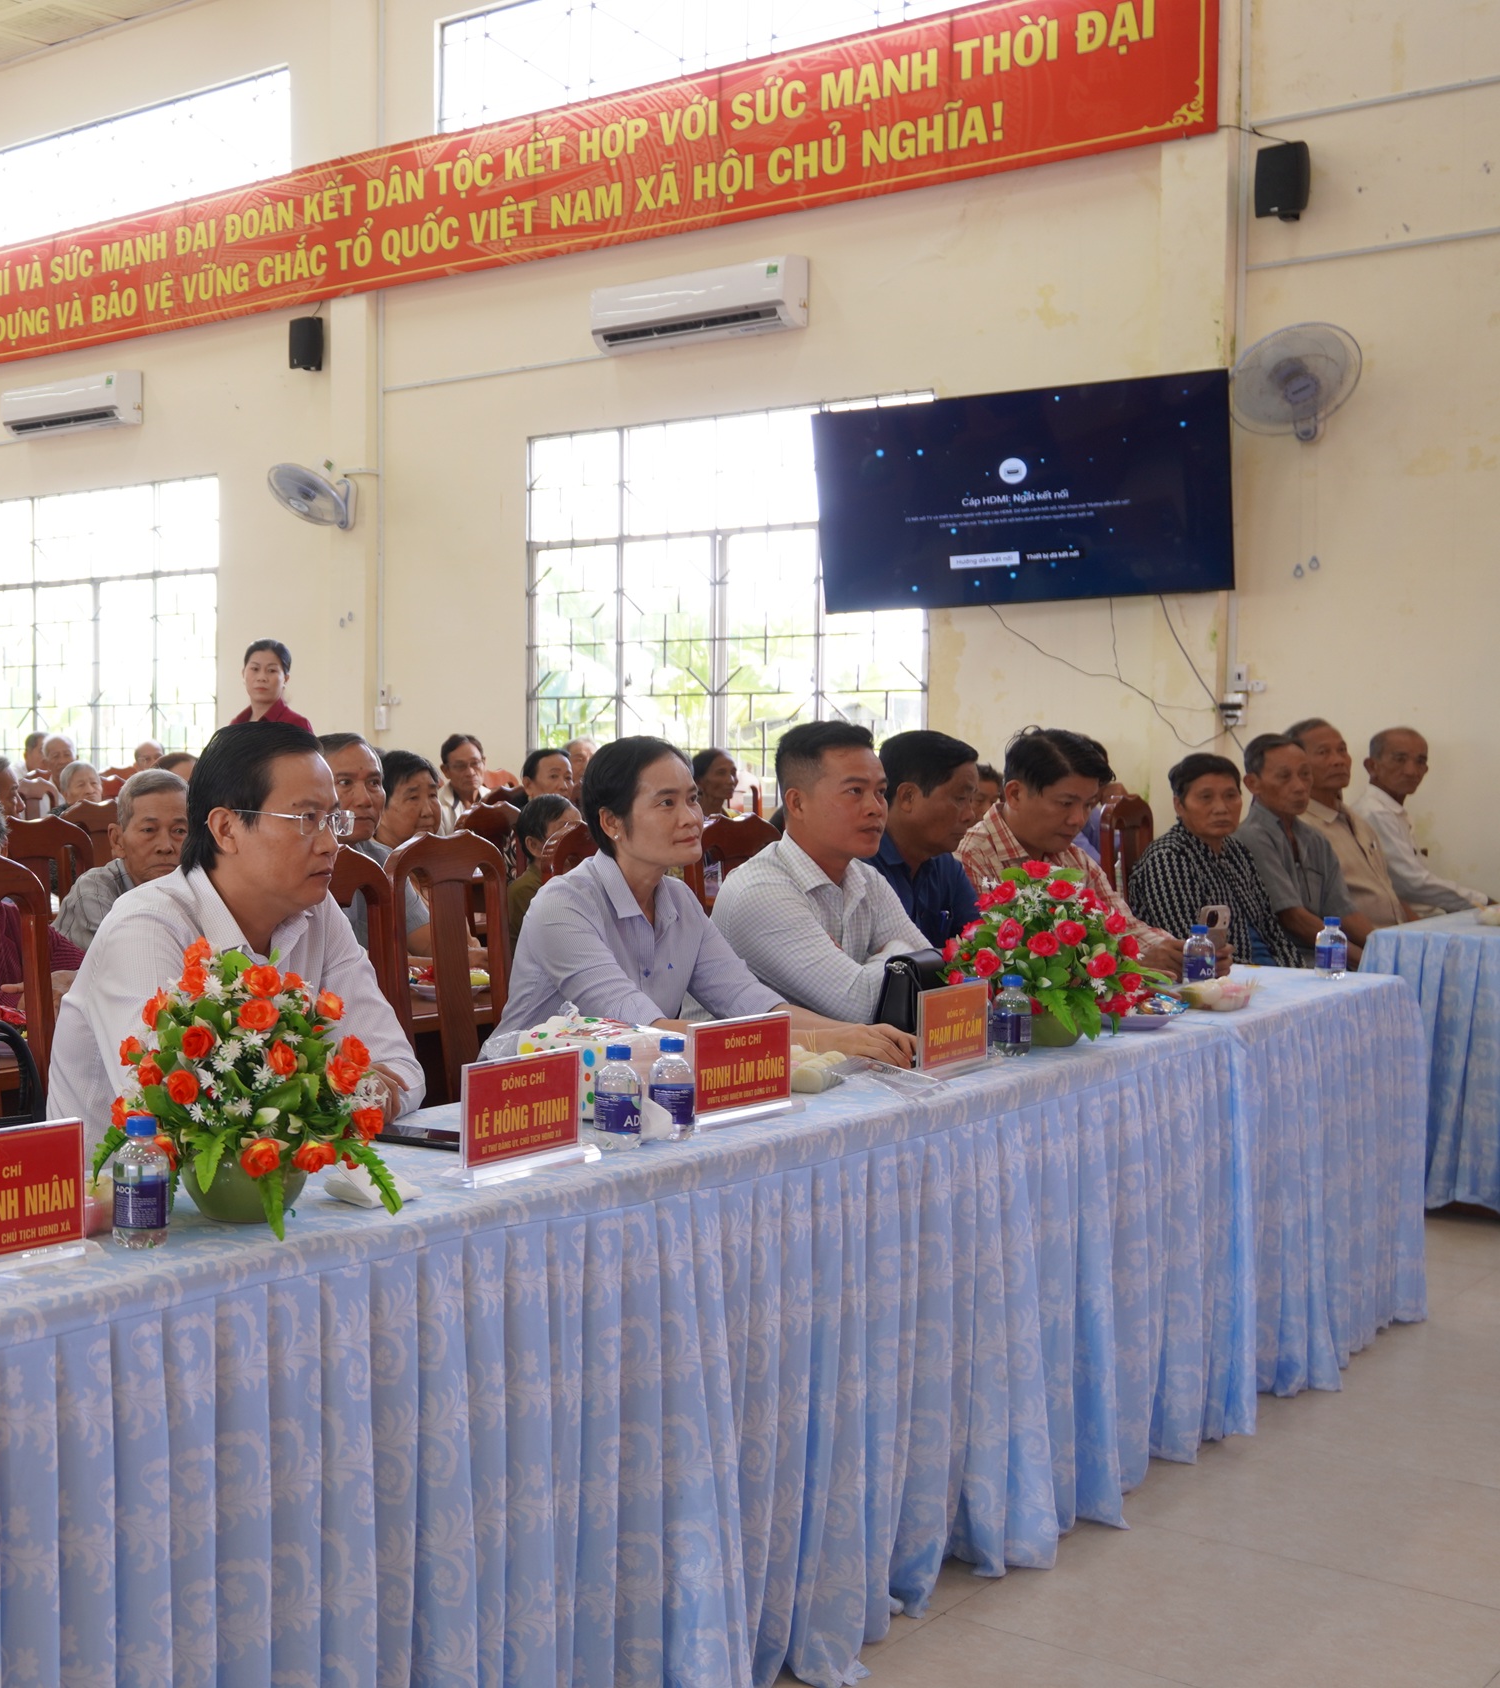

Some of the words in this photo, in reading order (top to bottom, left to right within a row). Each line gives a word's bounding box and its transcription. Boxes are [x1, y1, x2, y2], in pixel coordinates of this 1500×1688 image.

[15, 254, 44, 292] VÀ
[49, 246, 94, 285] SỨC
[100, 230, 168, 277] MẠNH
[174, 218, 217, 259] ĐẠI
[224, 199, 295, 245] ĐOÀN
[303, 174, 357, 226] KẾT
[366, 165, 426, 211] DÂN
[433, 149, 494, 199] TỘC
[502, 128, 567, 181] KẾT
[578, 115, 649, 167] HỢP
[659, 92, 718, 146] VỚI
[730, 76, 807, 131] SỨC
[820, 47, 938, 112] MẠNH
[953, 15, 1059, 80] THỜI
[1075, 0, 1155, 57] ĐẠI
[55, 293, 85, 330] VÀ
[91, 279, 138, 323] BẢO
[143, 271, 174, 316] VỆ
[181, 260, 250, 304] VỮNG
[256, 240, 327, 288] CHẮC
[335, 217, 373, 271] TỔ
[381, 206, 460, 266] QUỐC
[468, 199, 538, 246] VIỆT
[550, 181, 623, 229] NAM
[634, 161, 680, 213] XÃ
[693, 148, 754, 205] HỘI
[767, 121, 846, 189] CHỦ
[862, 100, 1003, 167] NGHĨA!
[961, 496, 981, 508] Cáp
[982, 494, 1012, 505] HDMI:
[1036, 489, 1052, 501] kết
[1053, 488, 1069, 499] nối
[725, 1033, 746, 1050] ĐỒNG
[748, 1031, 762, 1046] CHÍ
[928, 1025, 951, 1049] PHẠM
[501, 1072, 527, 1091] ĐỒNG
[529, 1067, 546, 1086] CHÍ
[700, 1065, 731, 1095] TRỊNH
[733, 1057, 755, 1086] LÂM
[757, 1050, 785, 1082] ĐỒNG
[474, 1107, 490, 1140] LÊ
[493, 1099, 529, 1136] HỒNG
[532, 1096, 569, 1130] THỊNH
[2, 1160, 23, 1179] CHÍ
[24, 1173, 76, 1217] NHÂN
[1, 1228, 18, 1244] CHỦ
[19, 1227, 37, 1243] TỊCH
[37, 1223, 60, 1238] UBND
[59, 1218, 72, 1232] XÃ
